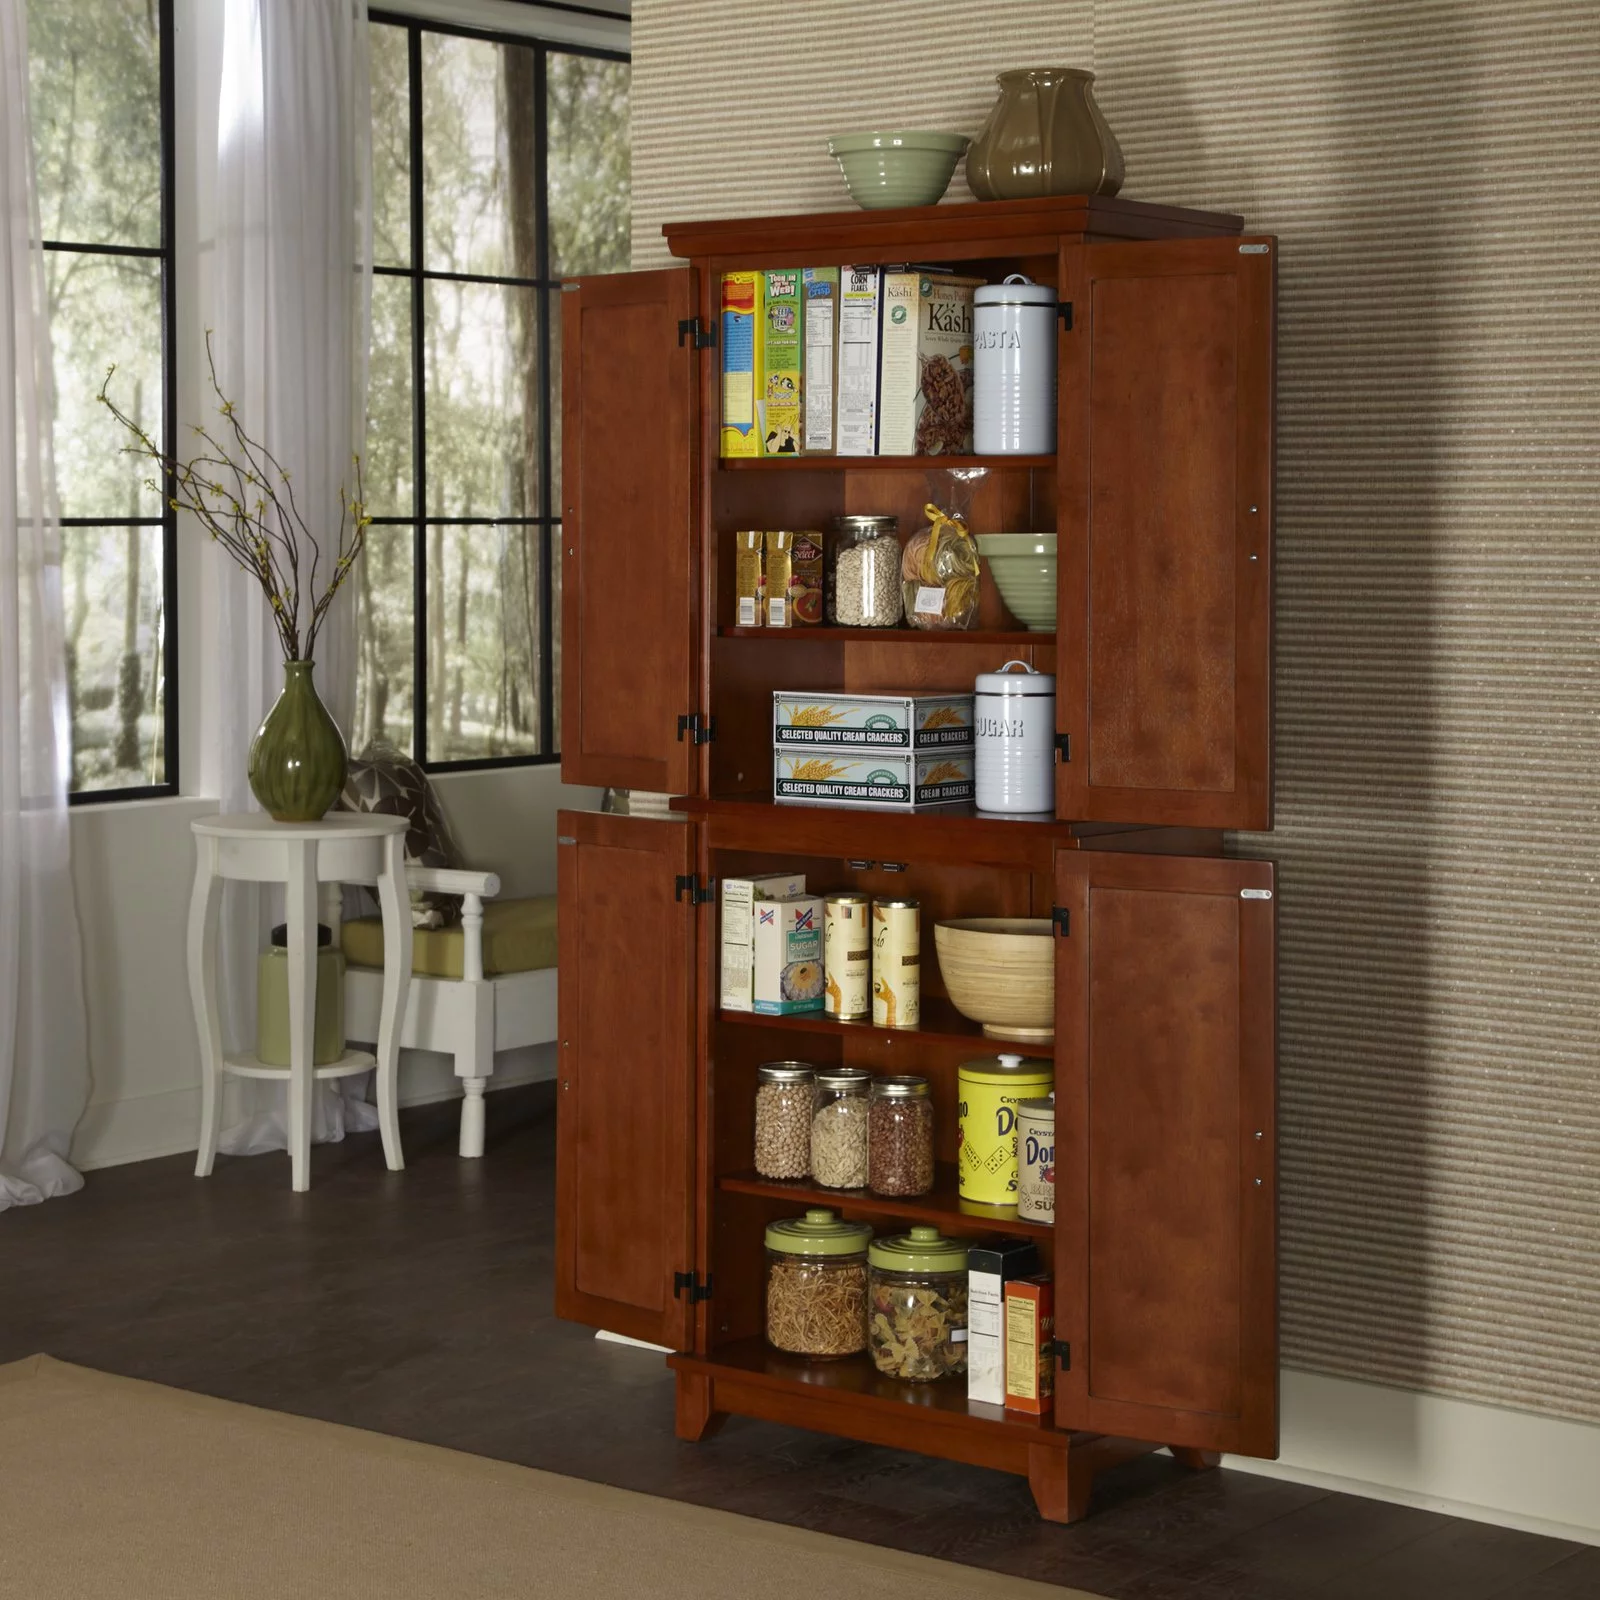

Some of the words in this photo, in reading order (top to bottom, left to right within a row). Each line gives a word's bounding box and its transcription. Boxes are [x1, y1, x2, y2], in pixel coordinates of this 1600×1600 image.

[850, 273, 868, 285] CORN
[850, 284, 868, 292] FLAKES
[887, 286, 912, 298] Kashi
[928, 302, 971, 333] Kash
[975, 331, 1021, 350] PASTA
[781, 729, 813, 740] SELECTED
[814, 730, 842, 742] QUALITY
[842, 731, 866, 742] CREAM
[866, 732, 903, 743] CRACKERS
[920, 732, 939, 744] CREAM
[940, 731, 968, 742] CRACKERS
[782, 782, 815, 794] SELECTED
[815, 784, 843, 796] QUALITY
[844, 785, 868, 797] CREAM
[868, 786, 904, 799] CRACKERS
[920, 787, 940, 799] CREAM
[941, 785, 970, 797] CRACKERS
[790, 940, 818, 951] SUGAR
[1034, 1200, 1055, 1211] SU
